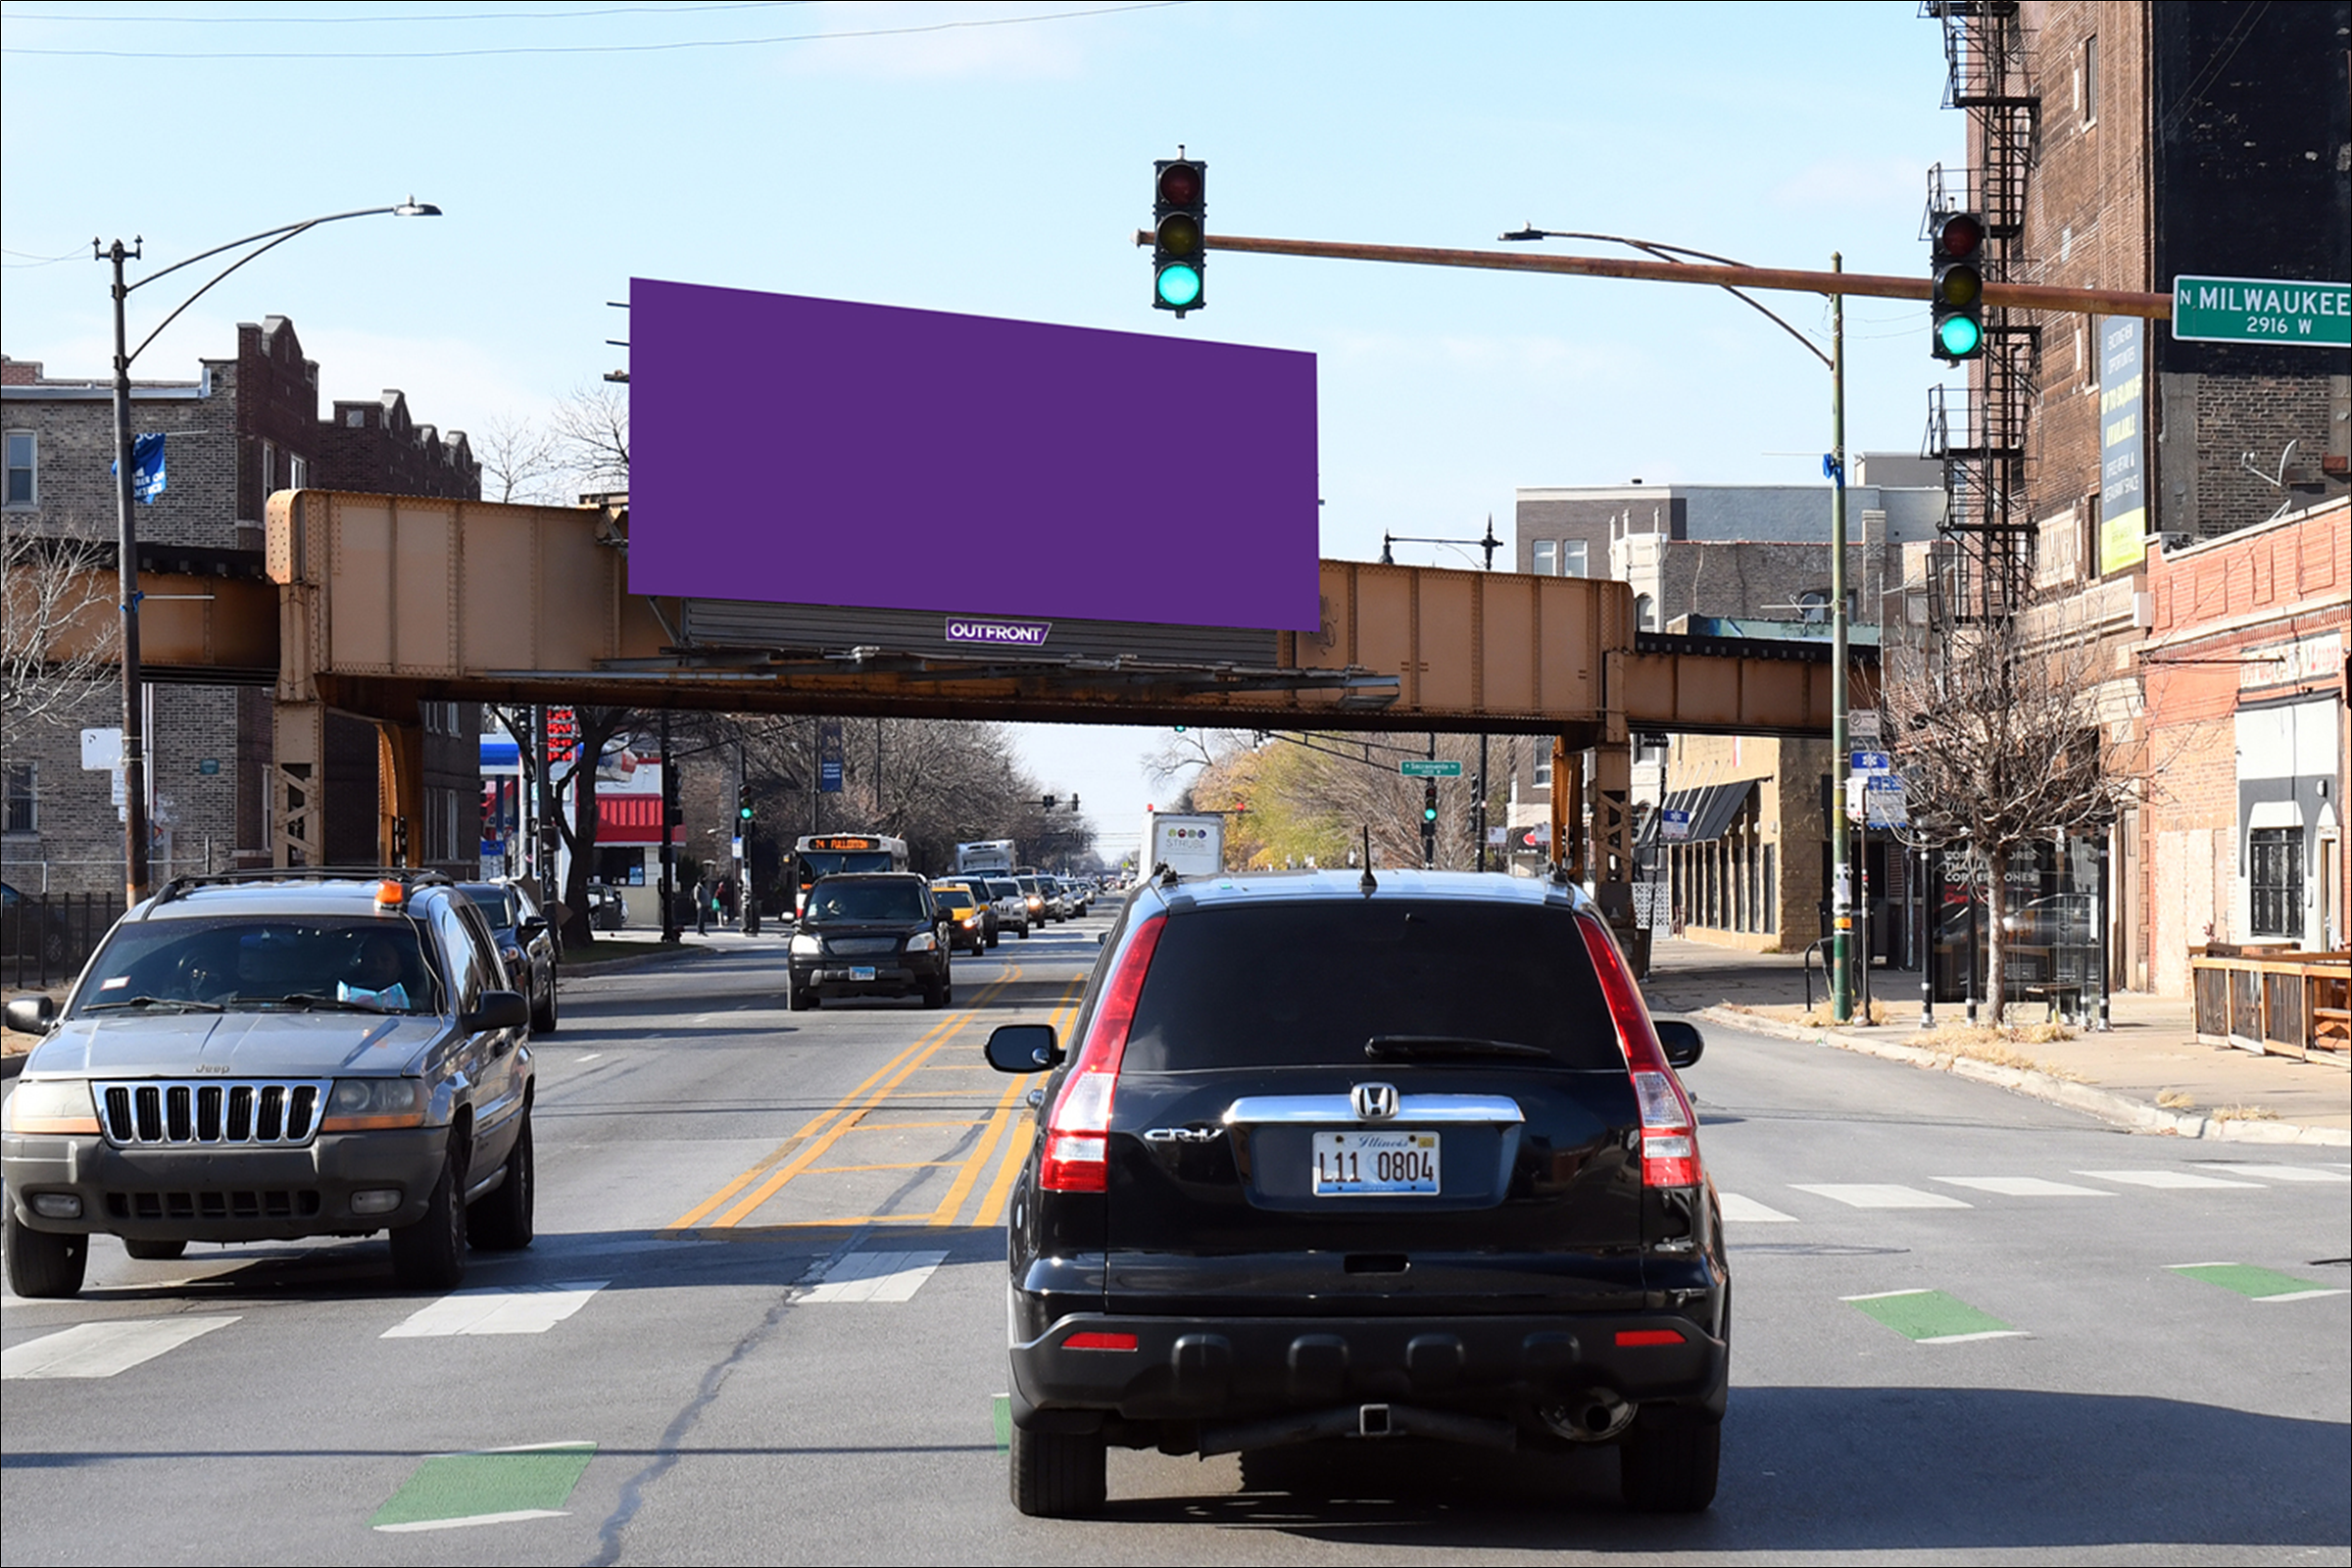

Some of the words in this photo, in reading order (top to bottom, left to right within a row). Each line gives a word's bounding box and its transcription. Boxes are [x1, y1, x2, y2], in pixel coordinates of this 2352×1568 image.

[2180, 289, 2191, 305] N
[2199, 286, 2351, 316] MILWAUKEE
[2246, 316, 2288, 334] 2916
[2298, 318, 2312, 334] W
[950, 622, 1042, 642] OUTFRONT
[196, 1063, 230, 1075] Jeep
[1144, 1127, 1224, 1143] CR-V
[1358, 1135, 1408, 1149] Illinois
[1319, 1151, 1361, 1183] L11
[1378, 1151, 1434, 1183] 0804
